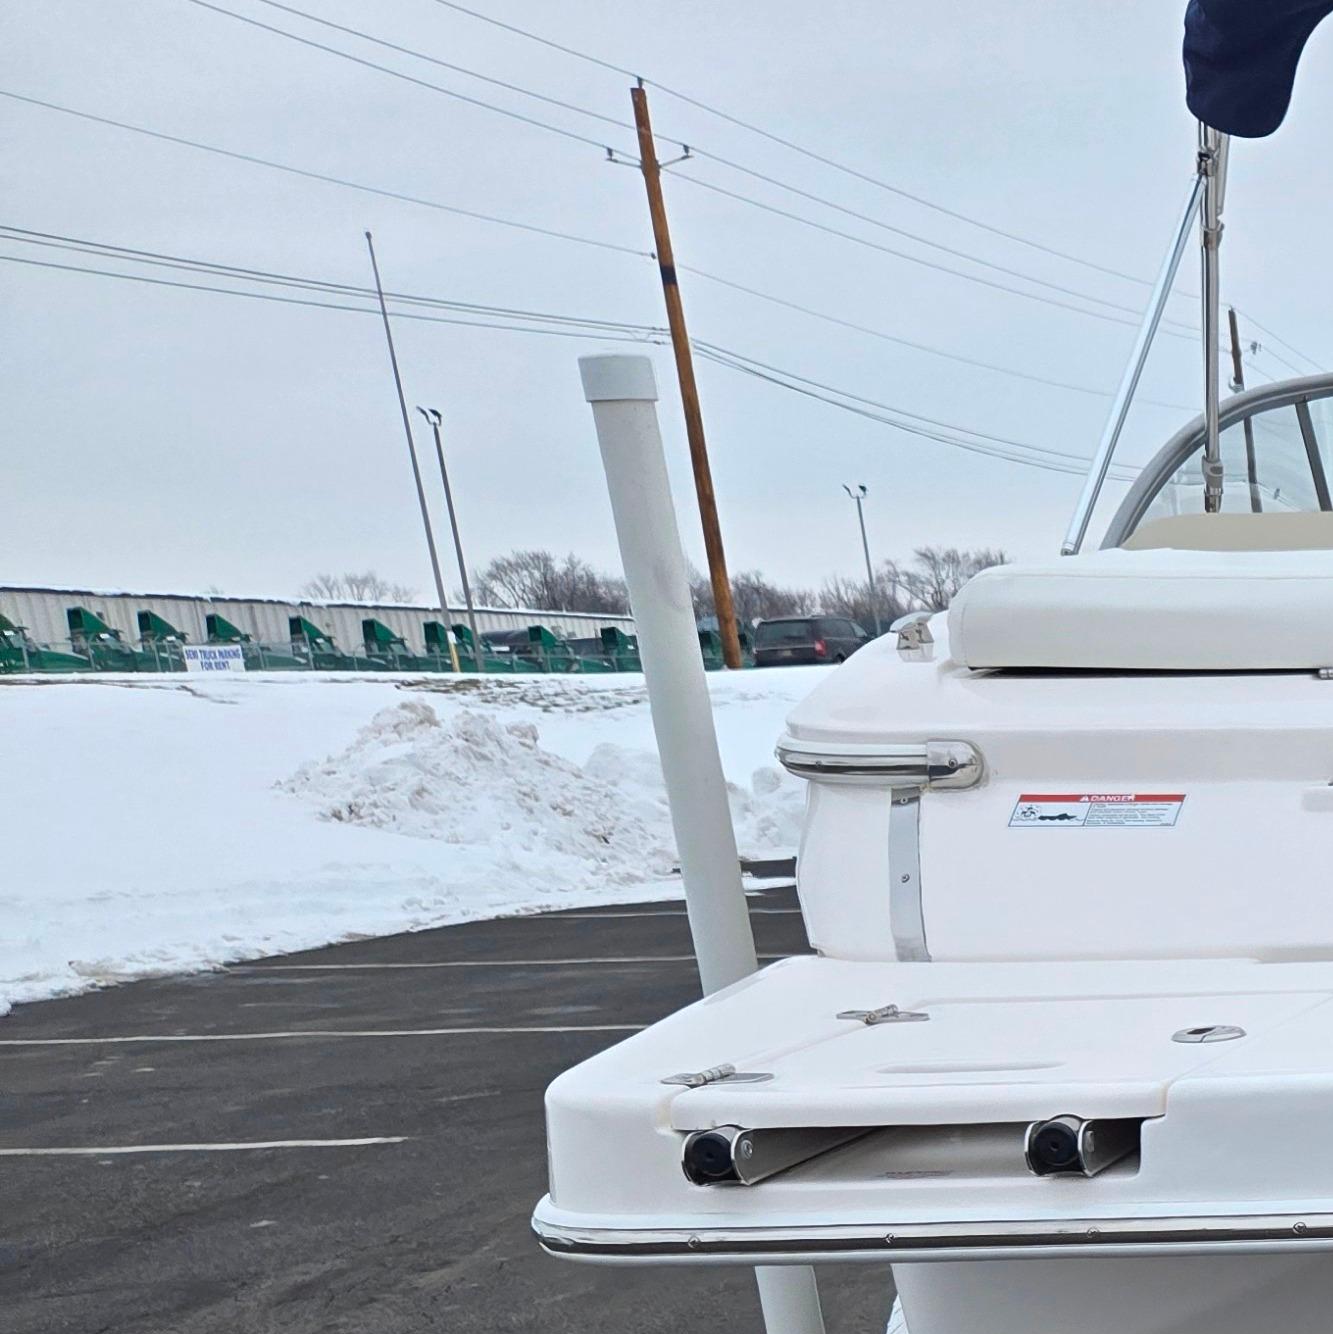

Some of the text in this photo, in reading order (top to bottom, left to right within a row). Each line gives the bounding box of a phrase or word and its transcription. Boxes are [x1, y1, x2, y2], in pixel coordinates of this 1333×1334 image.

[186, 649, 241, 660] SEMI TRUCK PARKING
[200, 660, 213, 671] FOR
[1090, 794, 1136, 802] DANGER
